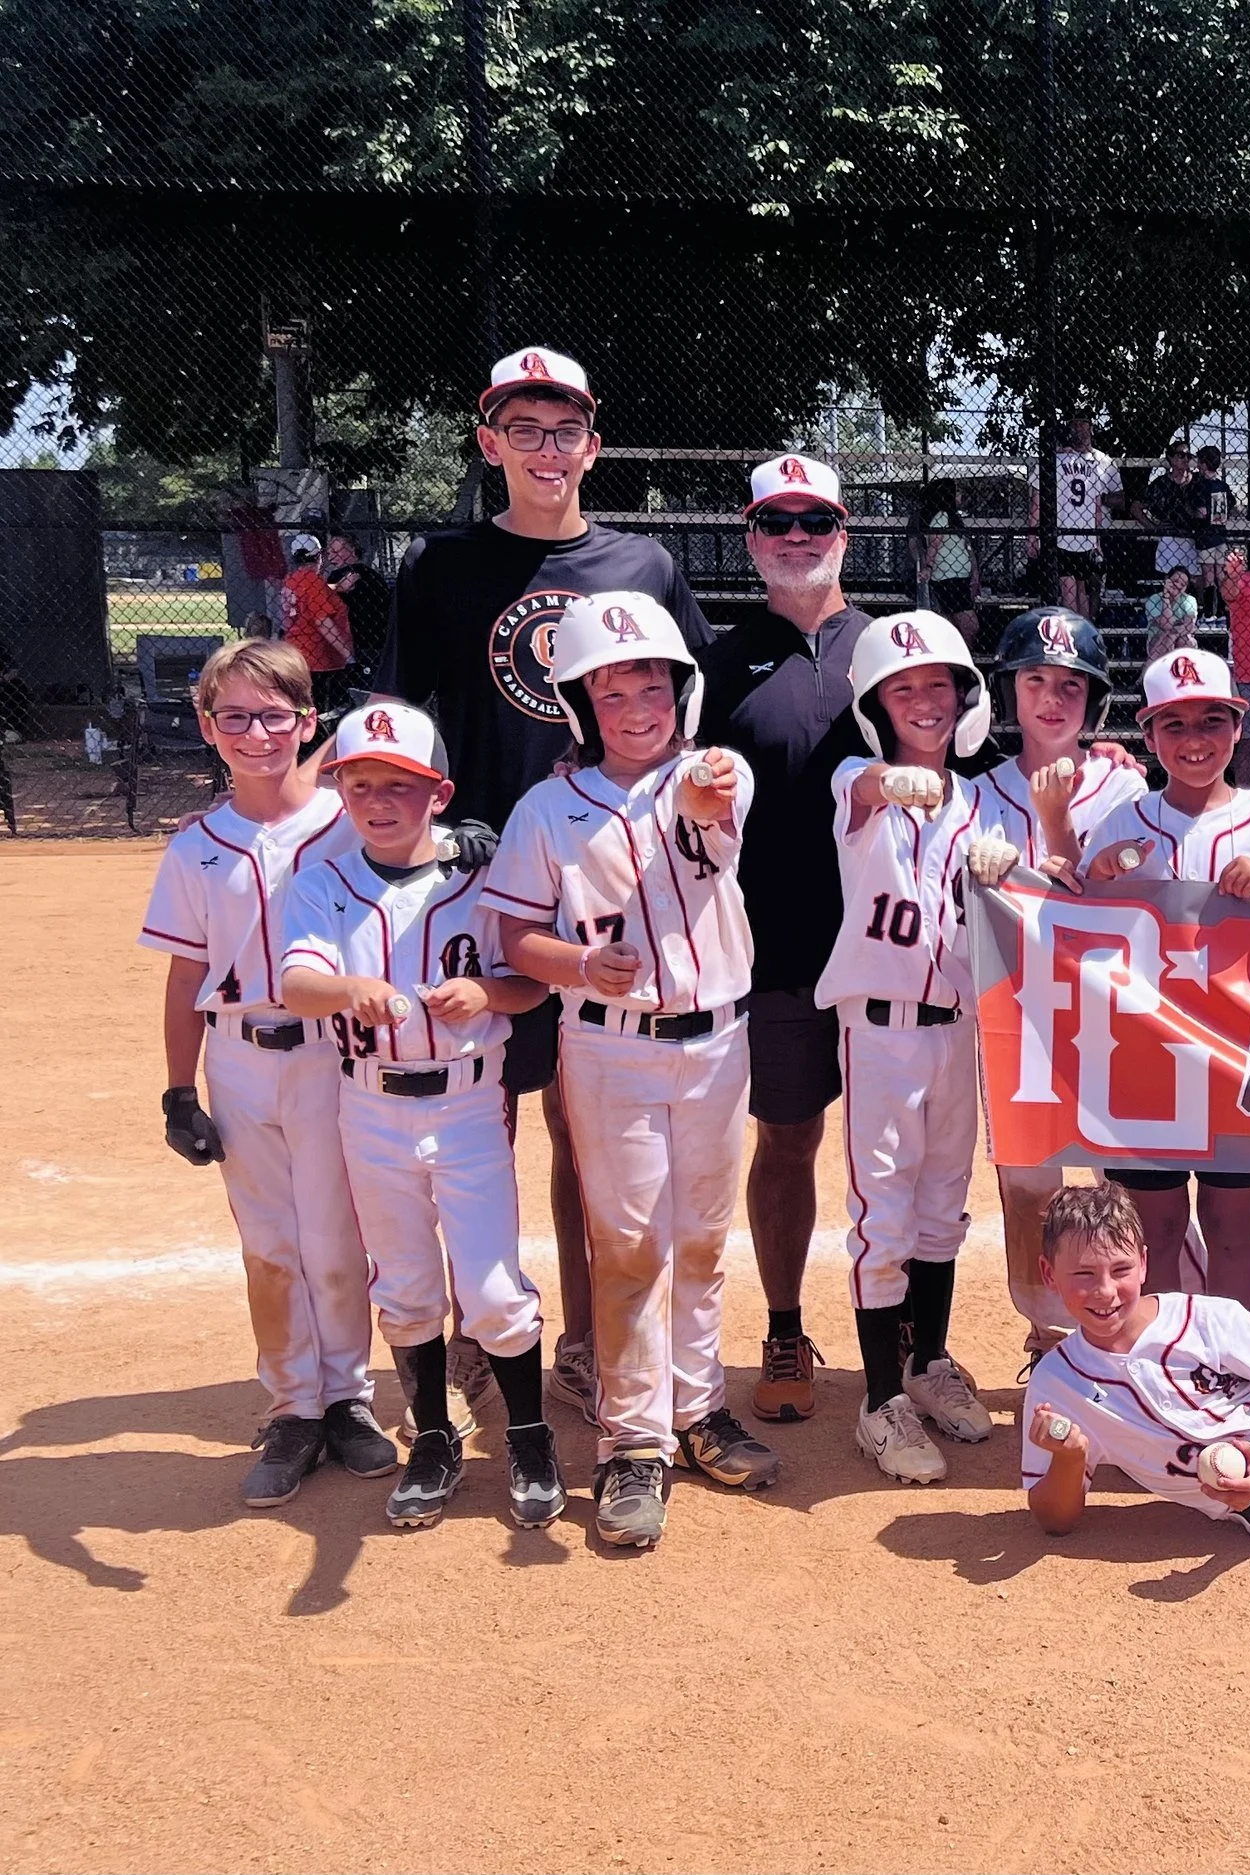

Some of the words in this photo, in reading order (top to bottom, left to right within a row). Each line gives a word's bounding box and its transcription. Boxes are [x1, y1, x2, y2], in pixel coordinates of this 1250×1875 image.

[1070, 478, 1086, 507] 9
[503, 673, 561, 716] BASEBALL
[865, 892, 921, 948] 10
[332, 1011, 376, 1059] 99
